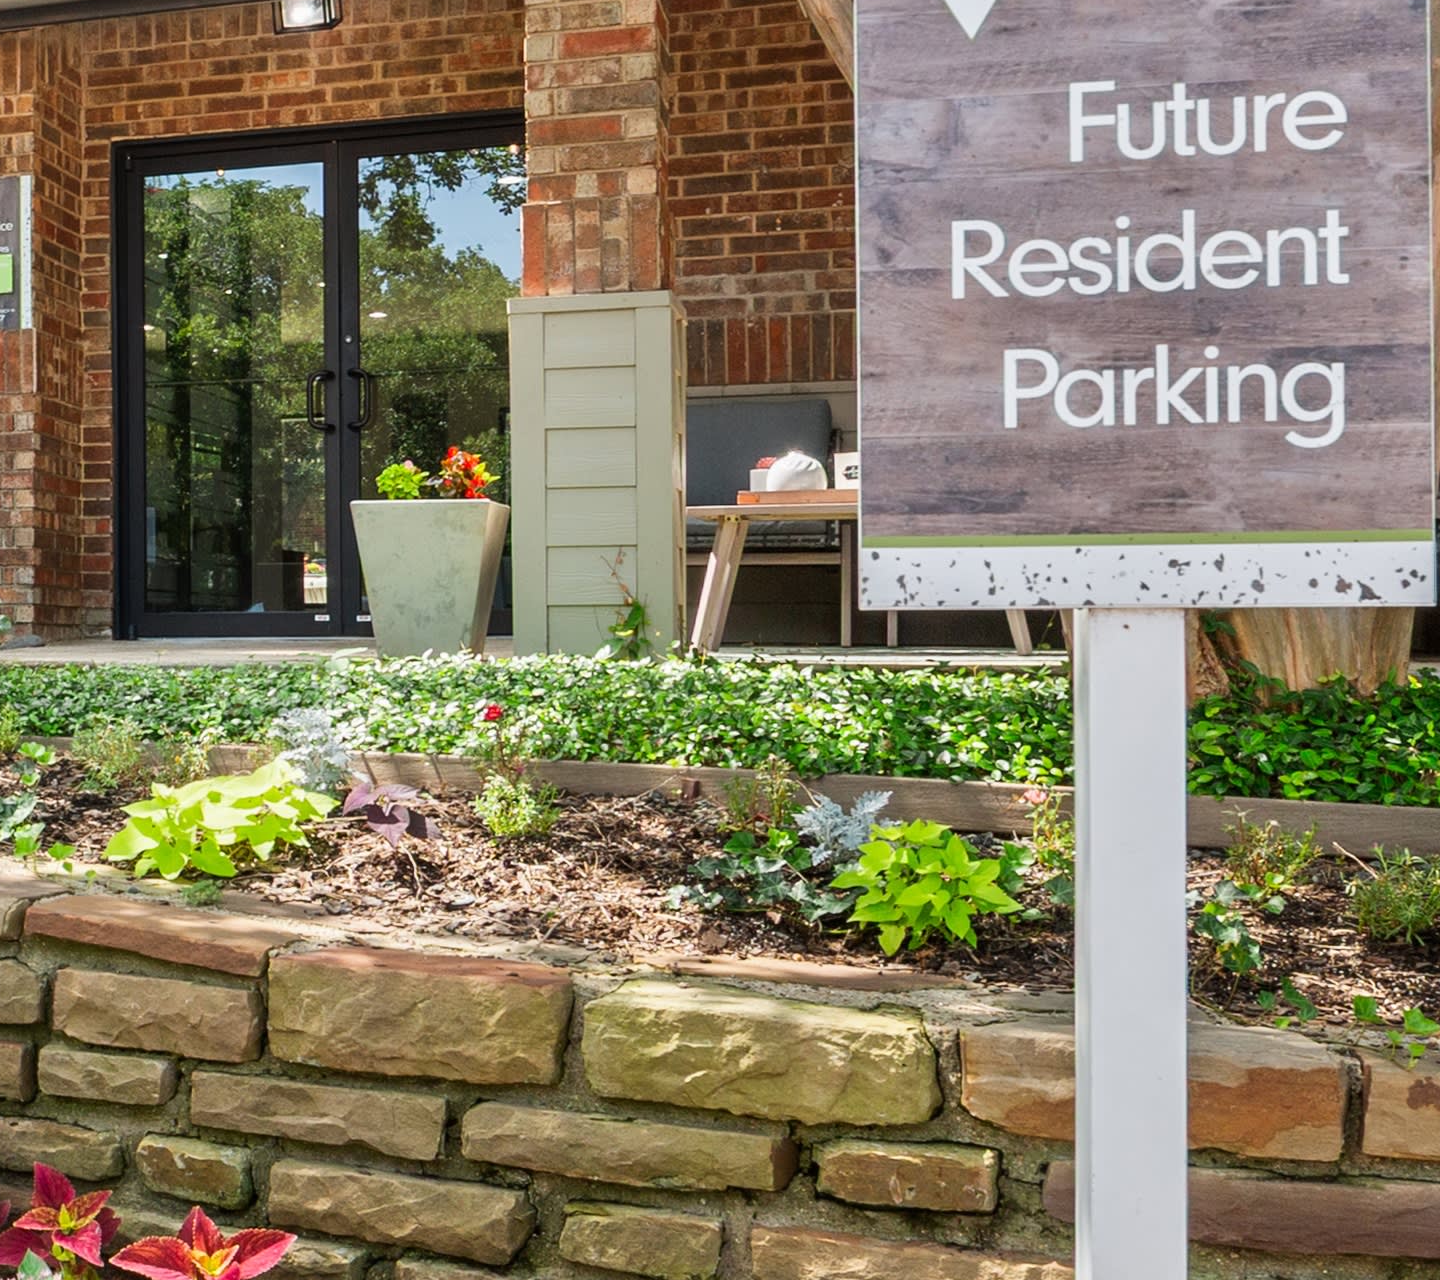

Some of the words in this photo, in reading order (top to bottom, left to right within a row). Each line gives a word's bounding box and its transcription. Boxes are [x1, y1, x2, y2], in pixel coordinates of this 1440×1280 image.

[1068, 79, 1347, 163] Future
[950, 209, 1350, 300] Resident
[1003, 344, 1346, 449] Parking
